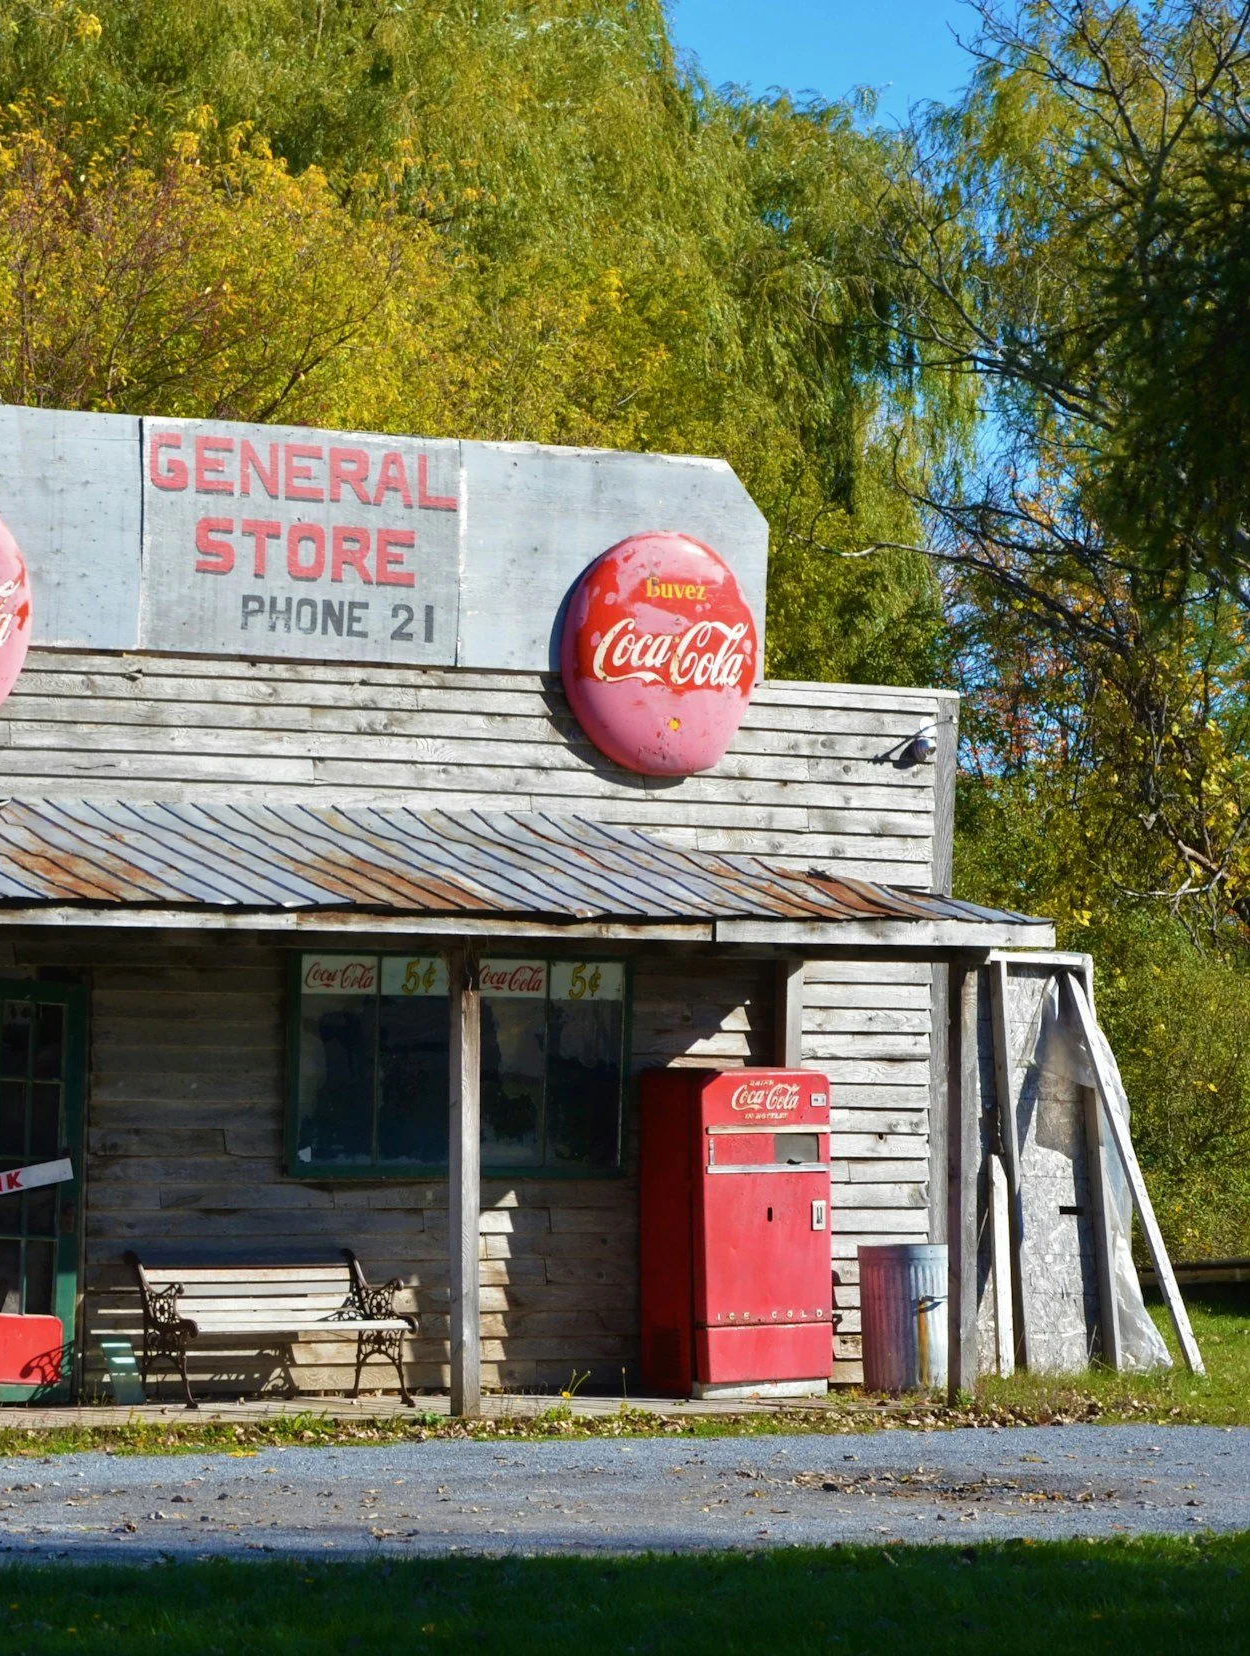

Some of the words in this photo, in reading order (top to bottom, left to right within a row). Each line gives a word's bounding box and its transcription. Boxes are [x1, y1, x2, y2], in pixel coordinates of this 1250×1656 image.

[150, 432, 458, 512] GENERAL
[195, 516, 416, 588] STORE
[645, 575, 708, 601] Buvez
[240, 594, 369, 639] PHONE
[390, 603, 434, 643] 21
[401, 958, 436, 995] 5¢
[568, 962, 601, 1000] 5¢
[717, 1311, 750, 1321] ICE
[771, 1308, 823, 1319] COLD
